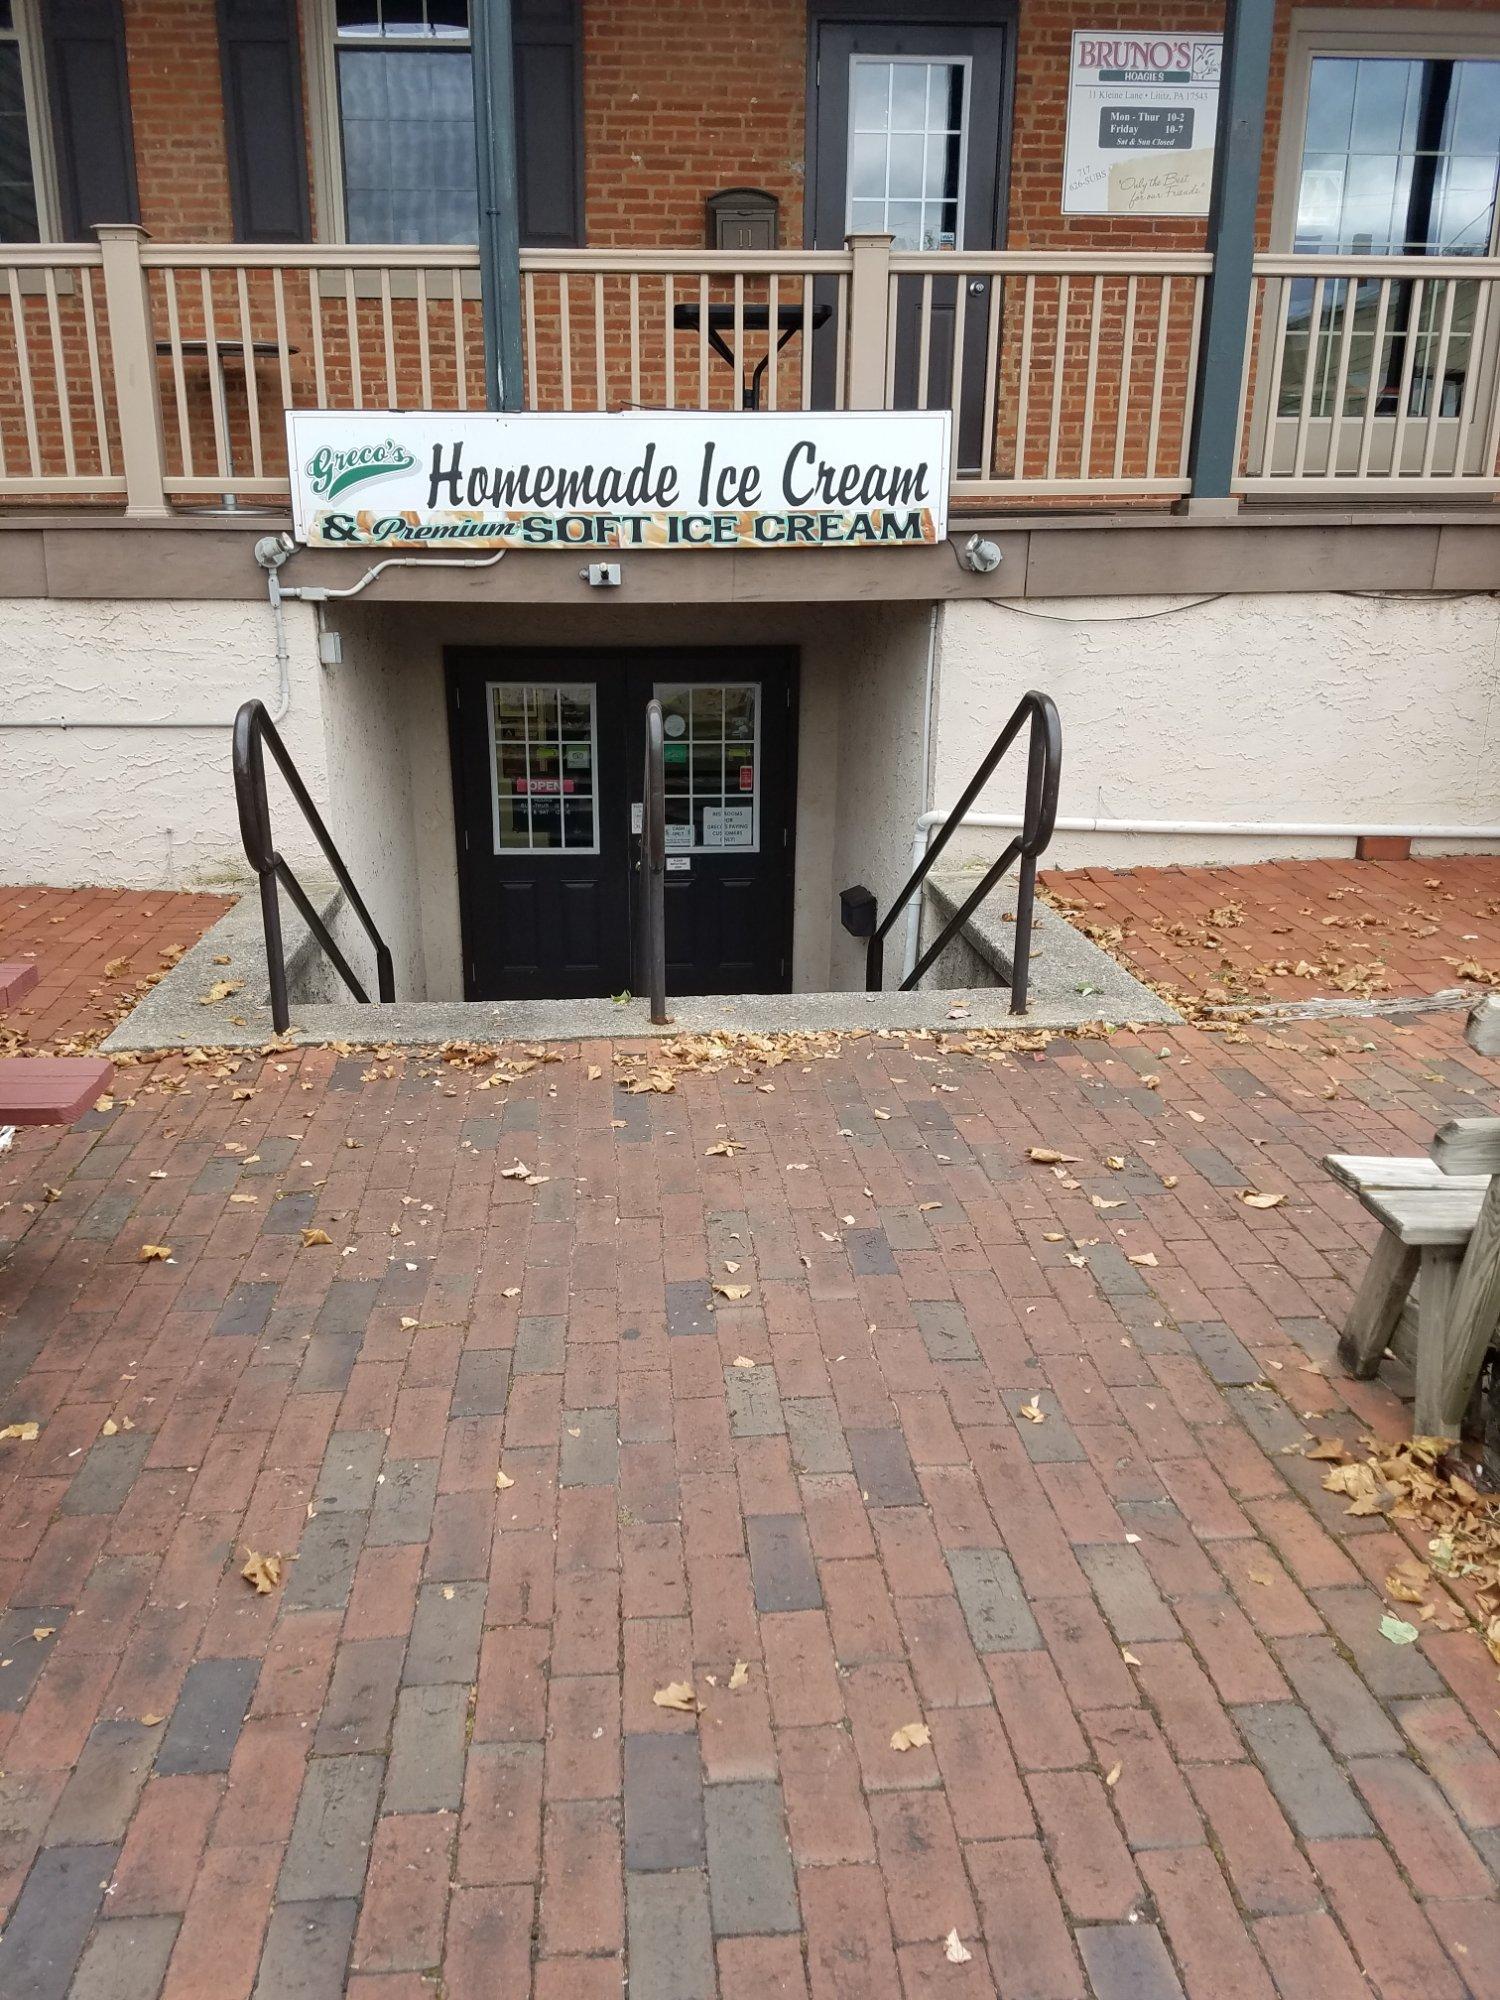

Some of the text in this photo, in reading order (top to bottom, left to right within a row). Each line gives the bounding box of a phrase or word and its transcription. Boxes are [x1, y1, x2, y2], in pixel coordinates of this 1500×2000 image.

[1078, 41, 1192, 70] BRUNO'S
[1124, 71, 1165, 82] HOAGIES
[1098, 90, 1123, 99] Kleine
[1125, 90, 1143, 99] Lane
[1173, 92, 1184, 101] PA
[1110, 112, 1130, 121] Mon
[1138, 112, 1160, 122] Thur
[1167, 113, 1185, 122] 10-2
[1110, 124, 1184, 135] Friday 10-7
[1116, 138, 1175, 146] Sat & Sun Closed
[1150, 176, 1161, 186] the
[1163, 172, 1191, 187] Best
[1129, 191, 1144, 209] for
[306, 440, 406, 493] Greco's
[427, 440, 929, 509] Homemade Ice Cream
[322, 512, 924, 544] & Premium SOFT ICE CREAM
[529, 781, 561, 791] OPEN
